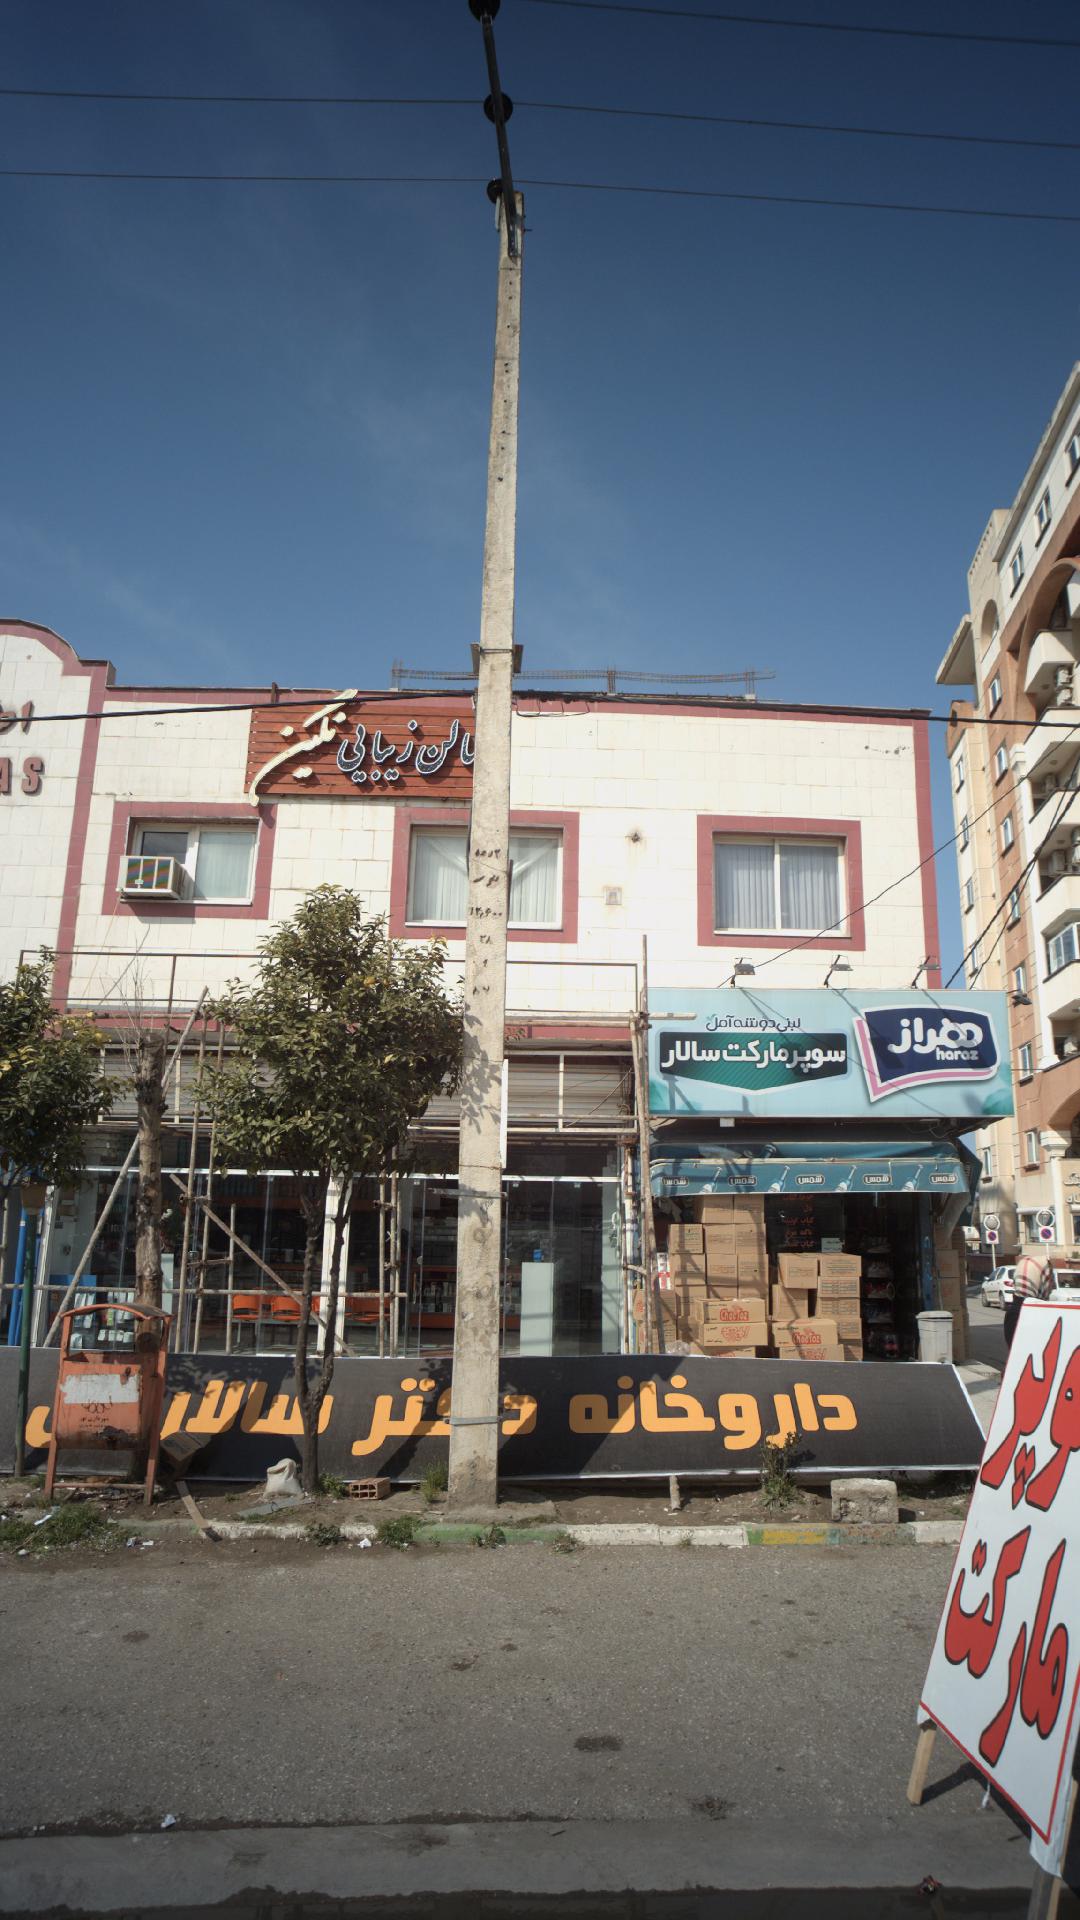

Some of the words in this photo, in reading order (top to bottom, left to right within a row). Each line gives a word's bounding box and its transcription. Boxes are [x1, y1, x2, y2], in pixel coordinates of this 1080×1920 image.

[337, 719, 418, 782] زیبایی
[415, 719, 475, 774] الن
[705, 1015, 735, 1031] آمل
[776, 1017, 801, 1032] لبنی
[887, 1017, 984, 1054] هراز
[660, 1040, 721, 1068] سالار
[722, 1040, 789, 1069] مارکت
[785, 1047, 847, 1073] سوپر
[935, 1046, 979, 1061] haraz
[797, 1173, 823, 1184] شمس
[864, 1174, 890, 1184] شمس
[569, 1375, 857, 1450] داروخانه
[981, 1317, 1080, 1512] وپر
[945, 1525, 1068, 1767] مارکت
